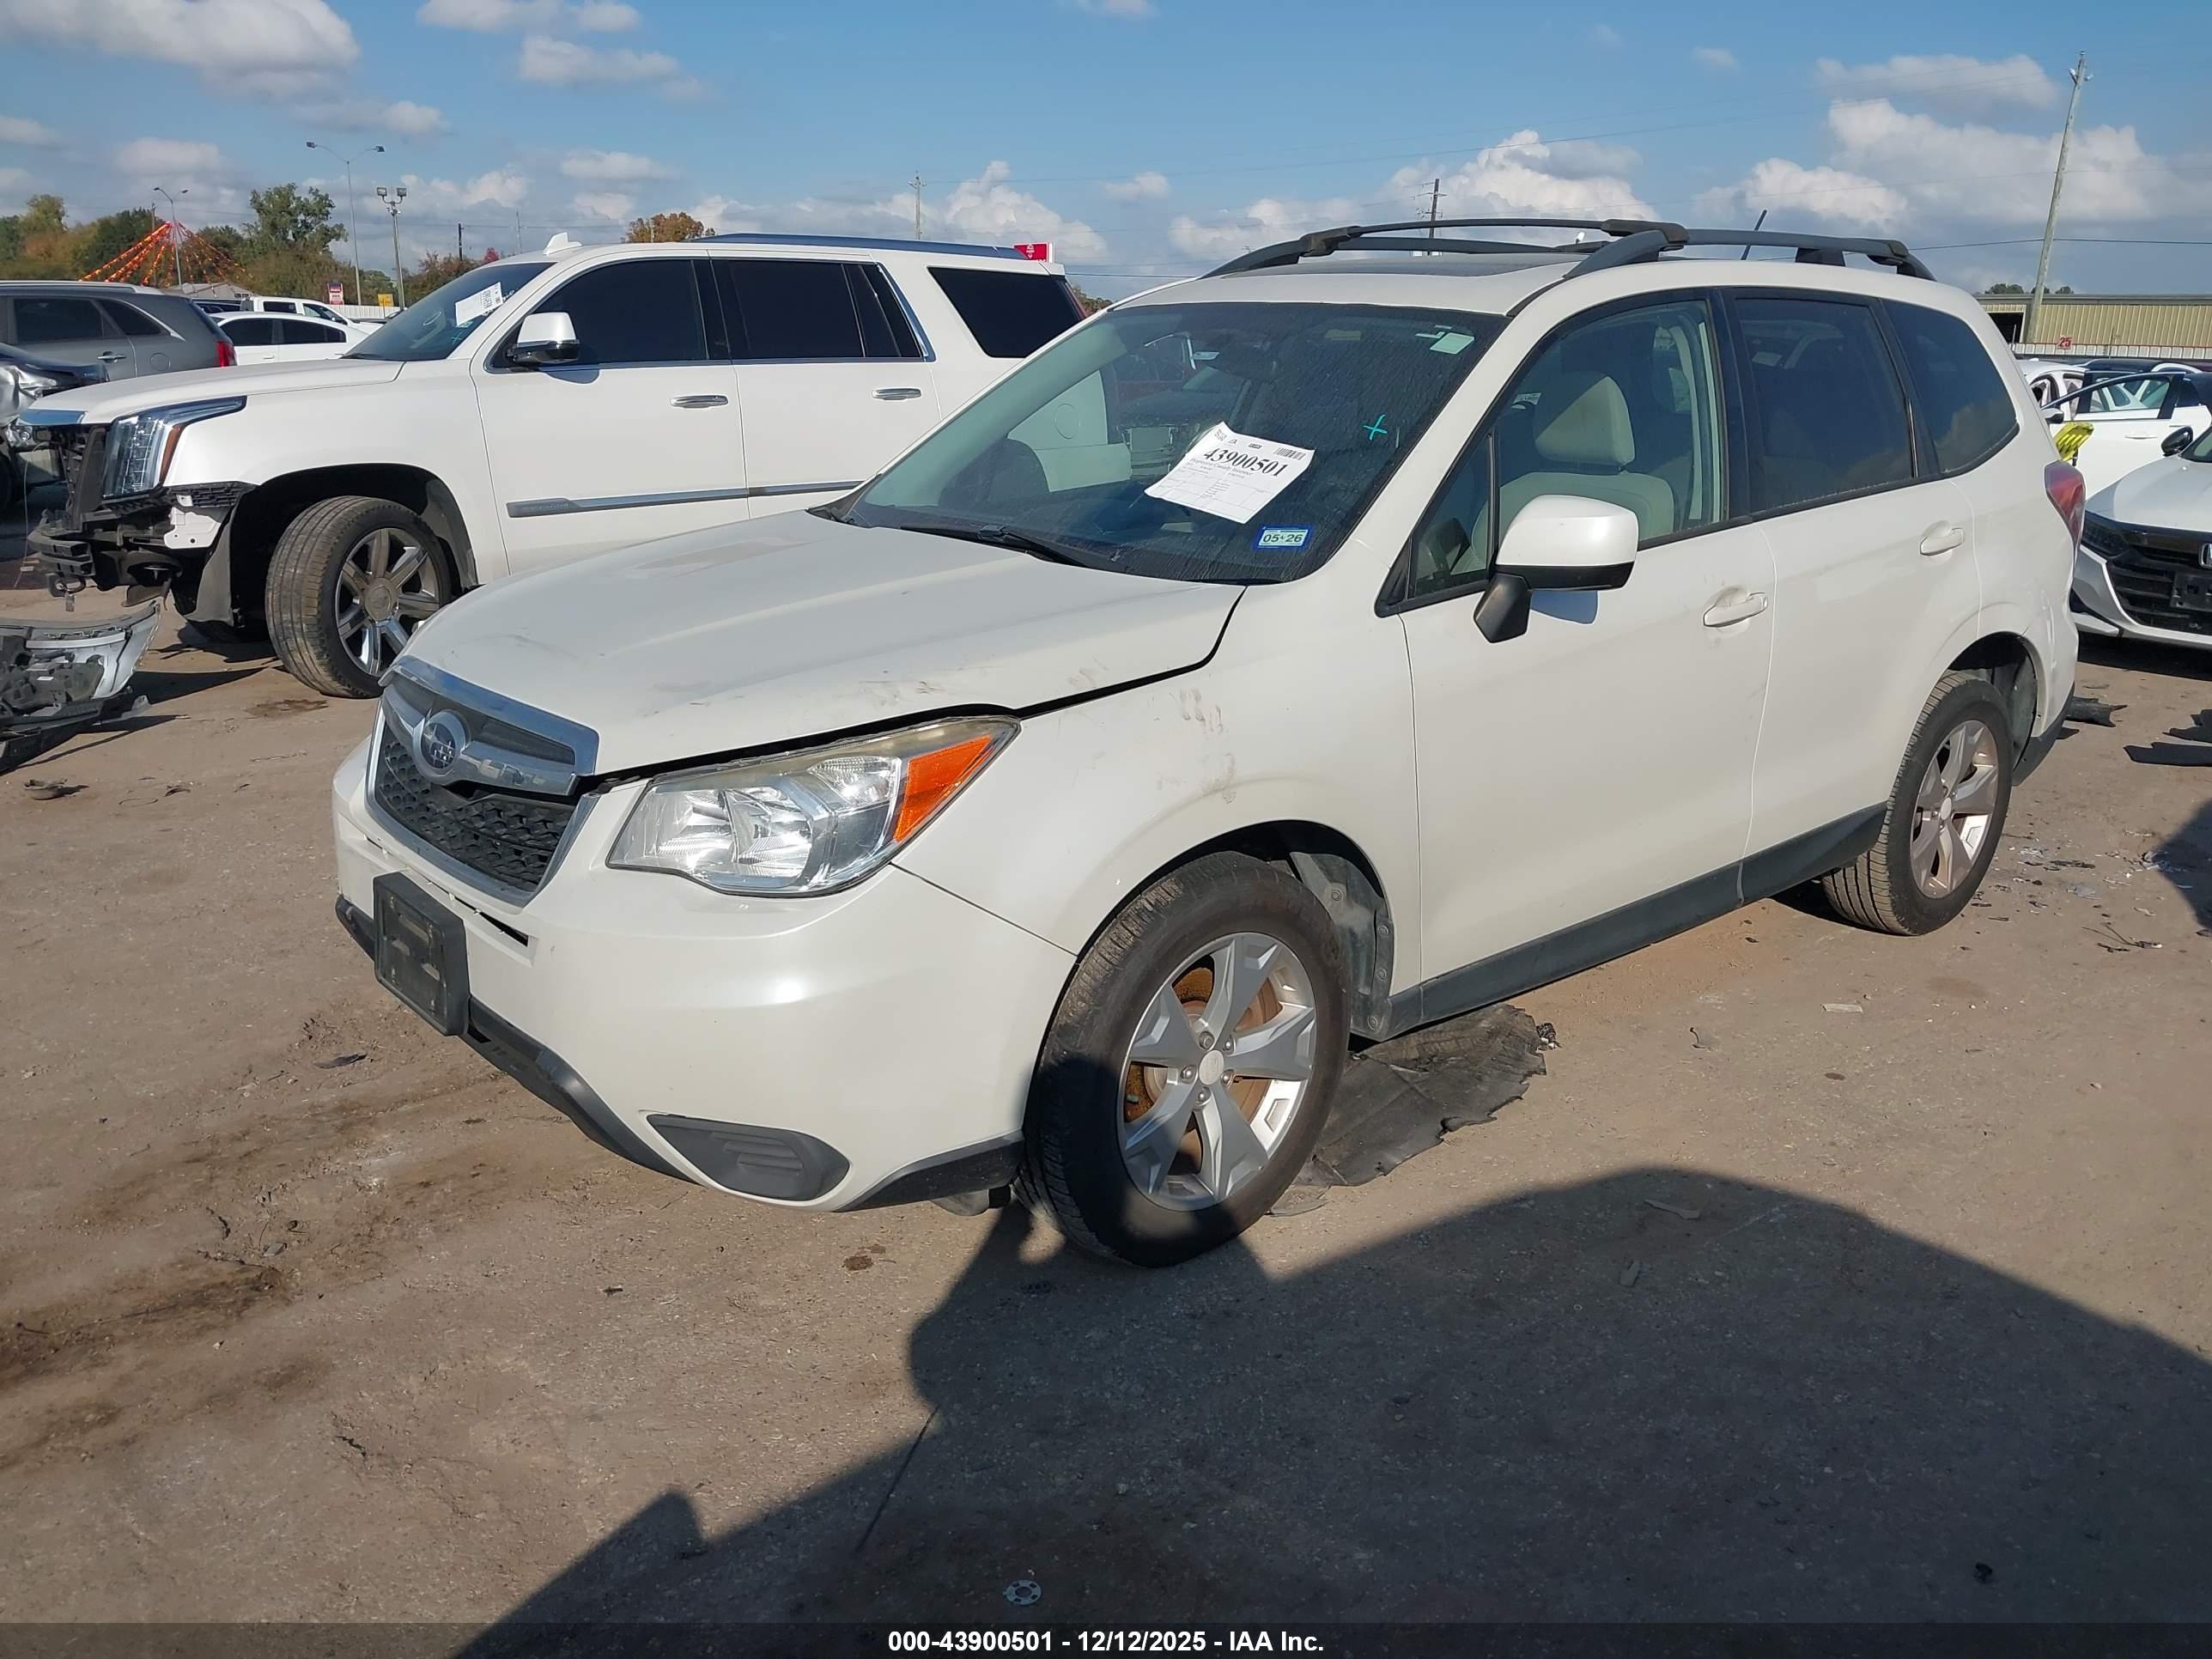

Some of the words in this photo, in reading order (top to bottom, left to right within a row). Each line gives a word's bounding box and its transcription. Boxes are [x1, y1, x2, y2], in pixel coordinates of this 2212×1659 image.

[2059, 337, 2072, 347] 25
[1203, 447, 1289, 477] 43900501
[1262, 533, 1280, 543] 05
[1285, 533, 1304, 543] 26
